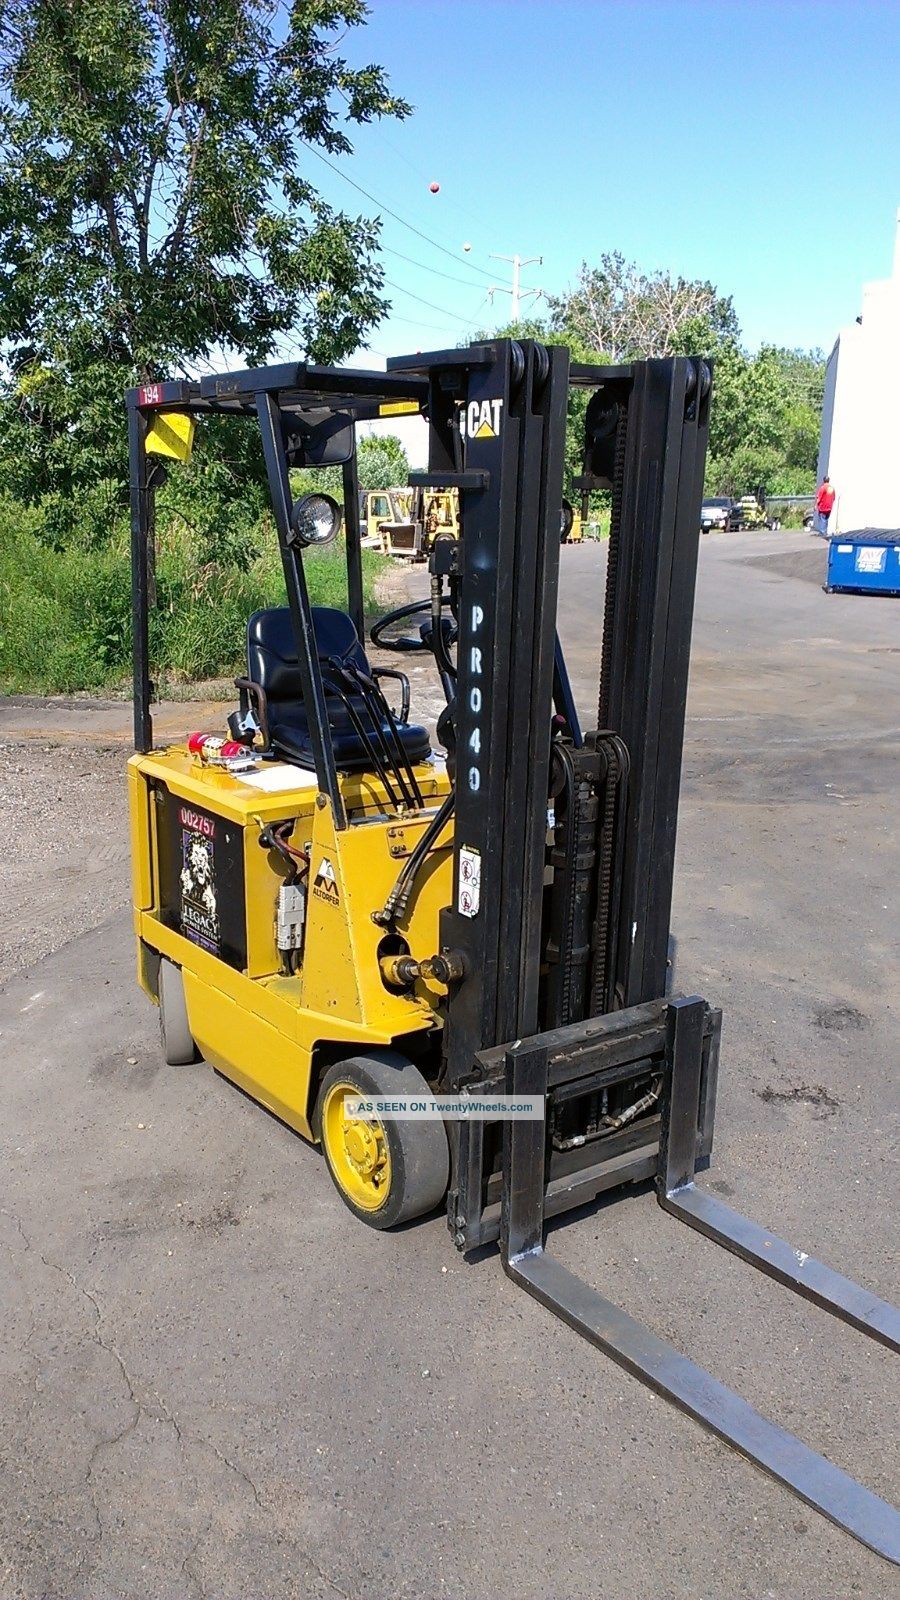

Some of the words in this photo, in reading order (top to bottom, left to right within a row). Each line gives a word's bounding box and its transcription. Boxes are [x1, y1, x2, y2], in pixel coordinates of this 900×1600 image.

[143, 386, 159, 404] 194
[467, 399, 503, 438] CAT
[180, 807, 215, 836] 002757
[313, 887, 340, 906] ALTORFER
[183, 904, 218, 934] LEGACY
